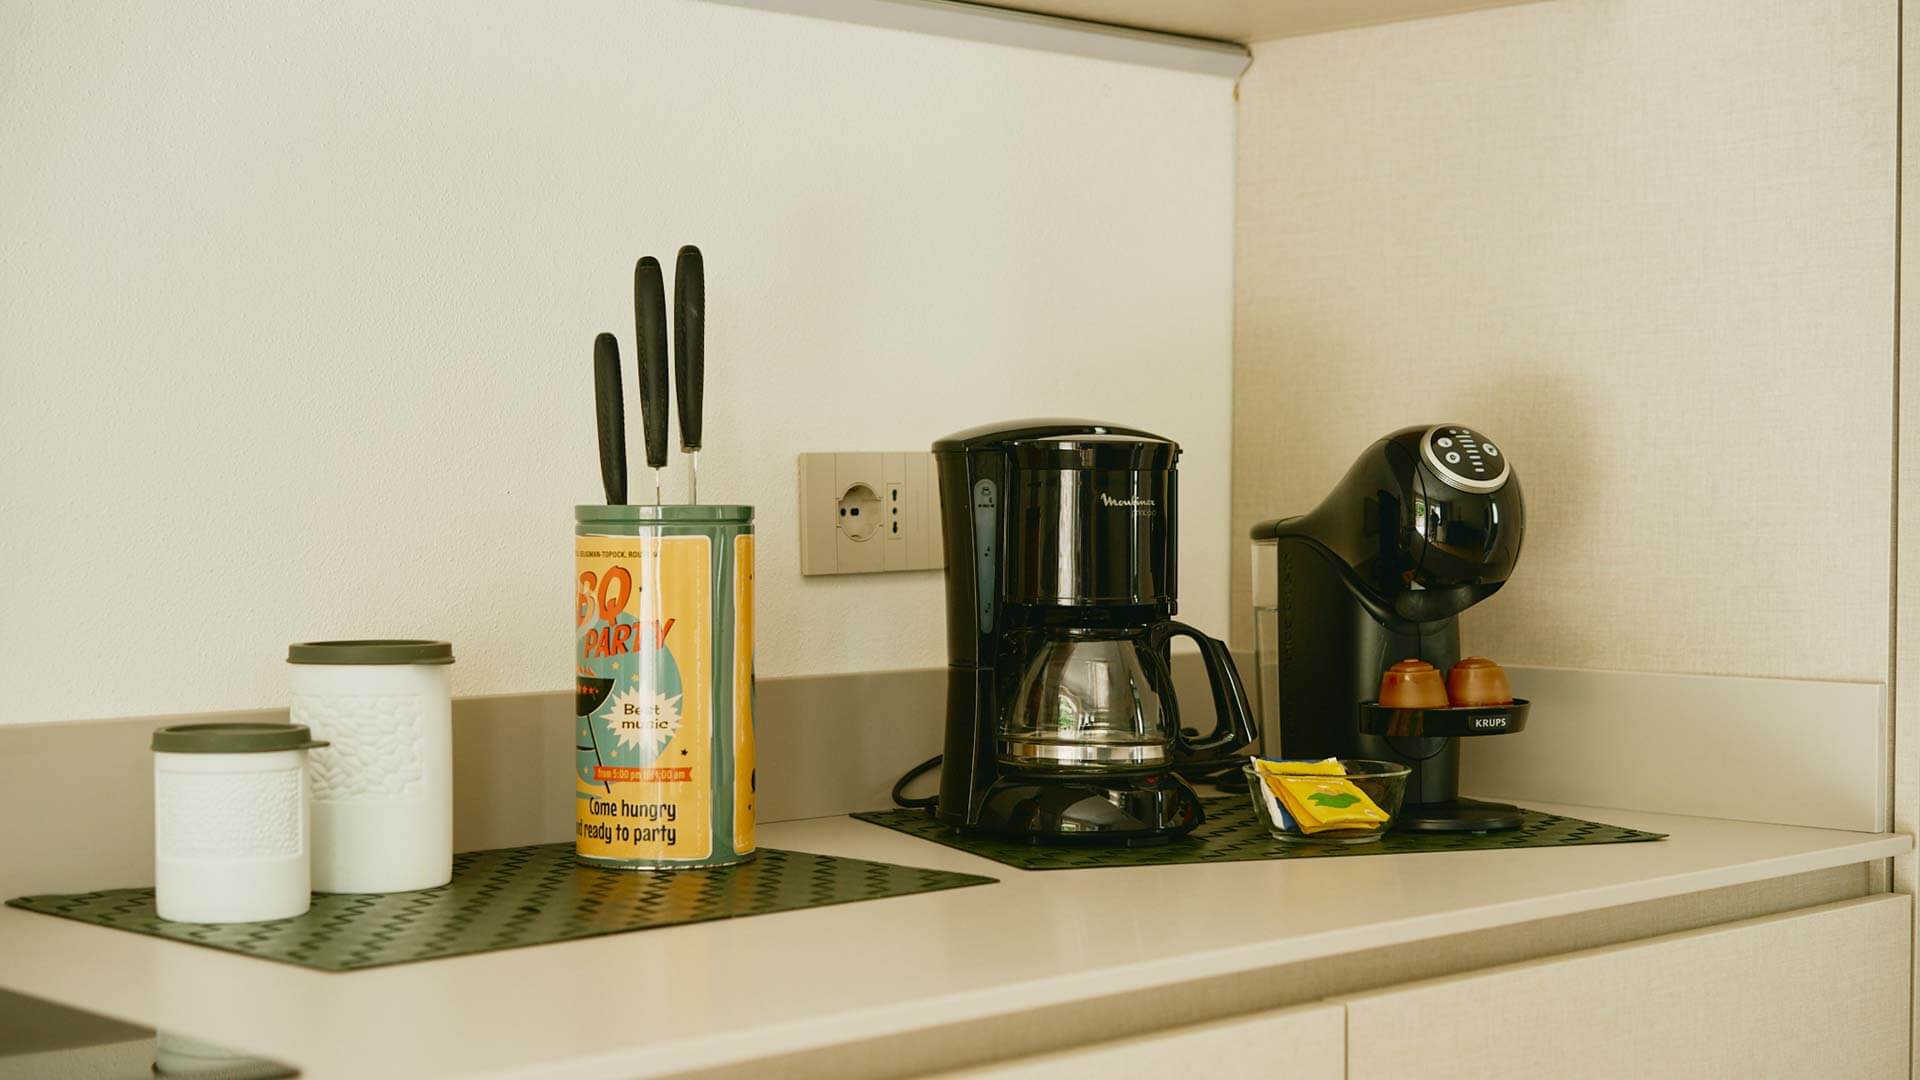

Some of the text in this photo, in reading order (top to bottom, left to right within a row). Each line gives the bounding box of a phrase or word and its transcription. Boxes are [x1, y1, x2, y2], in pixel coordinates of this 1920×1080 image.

[577, 565, 632, 627] BQ
[584, 618, 676, 659] PARTY
[624, 703, 661, 716] Bet
[621, 718, 669, 729] muic
[1475, 718, 1507, 729] KRUPS
[589, 797, 677, 822] Come hungry
[583, 822, 612, 845] ready
[615, 824, 629, 841] to
[633, 824, 676, 846] party
